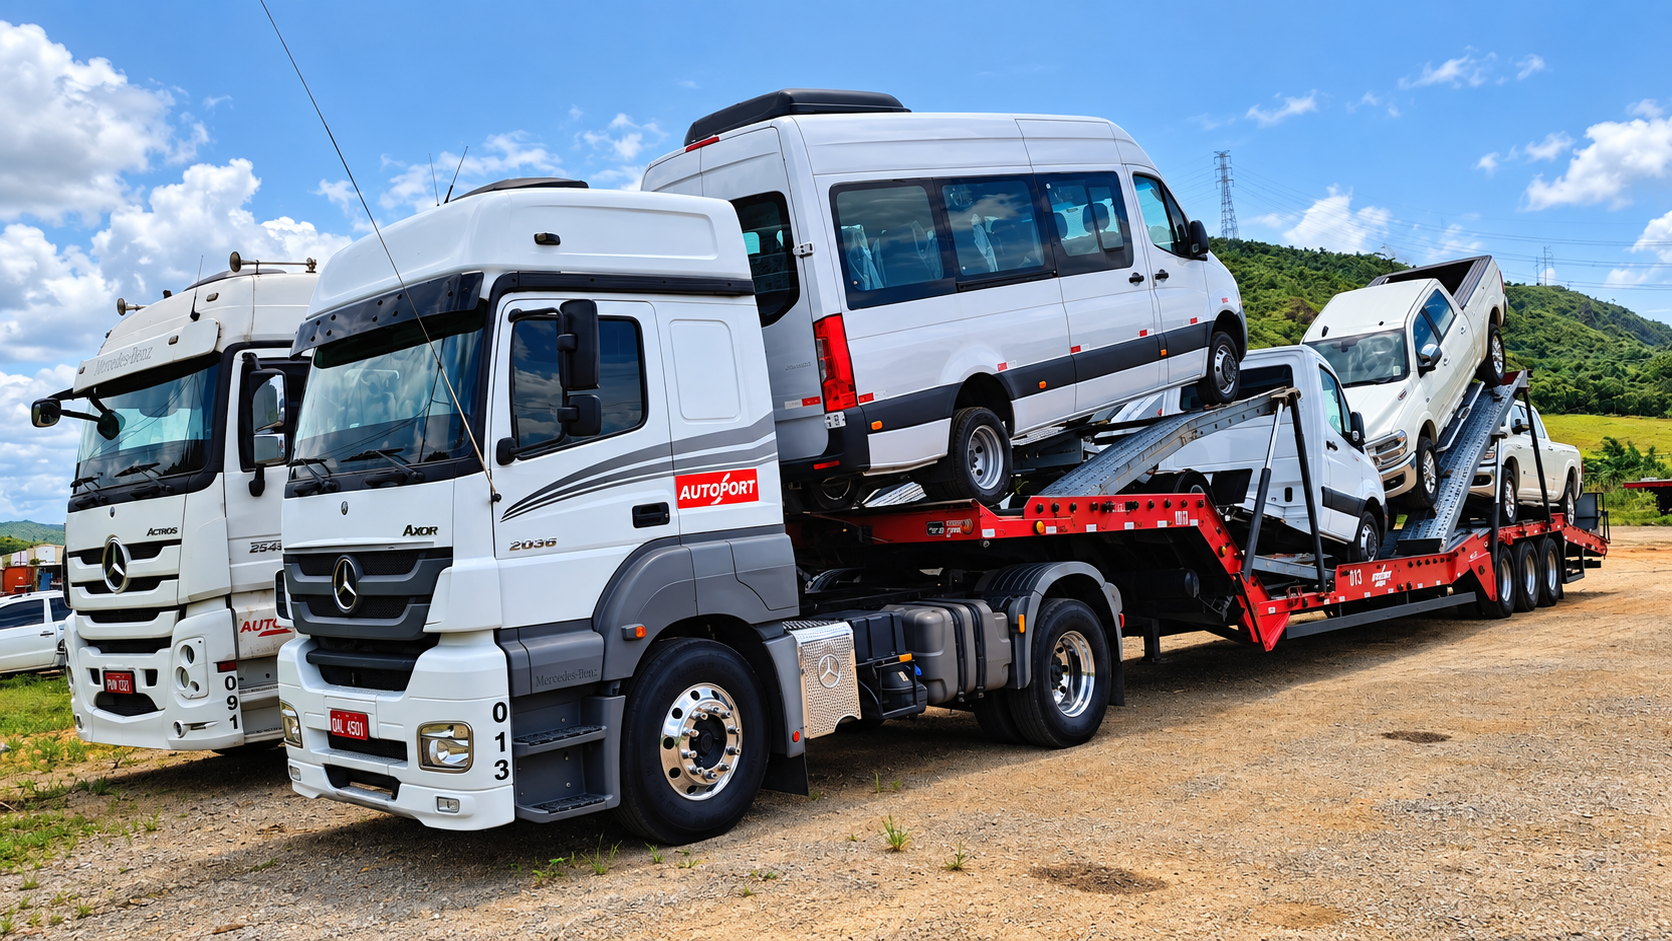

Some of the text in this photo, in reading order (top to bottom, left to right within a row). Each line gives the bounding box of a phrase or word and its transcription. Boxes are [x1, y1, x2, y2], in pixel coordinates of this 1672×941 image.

[679, 475, 756, 502] AUTOPORT
[509, 537, 558, 551] 2036
[1349, 568, 1363, 586] 013
[535, 668, 598, 687] Mercedes-Benz
[347, 720, 364, 737] 4501
